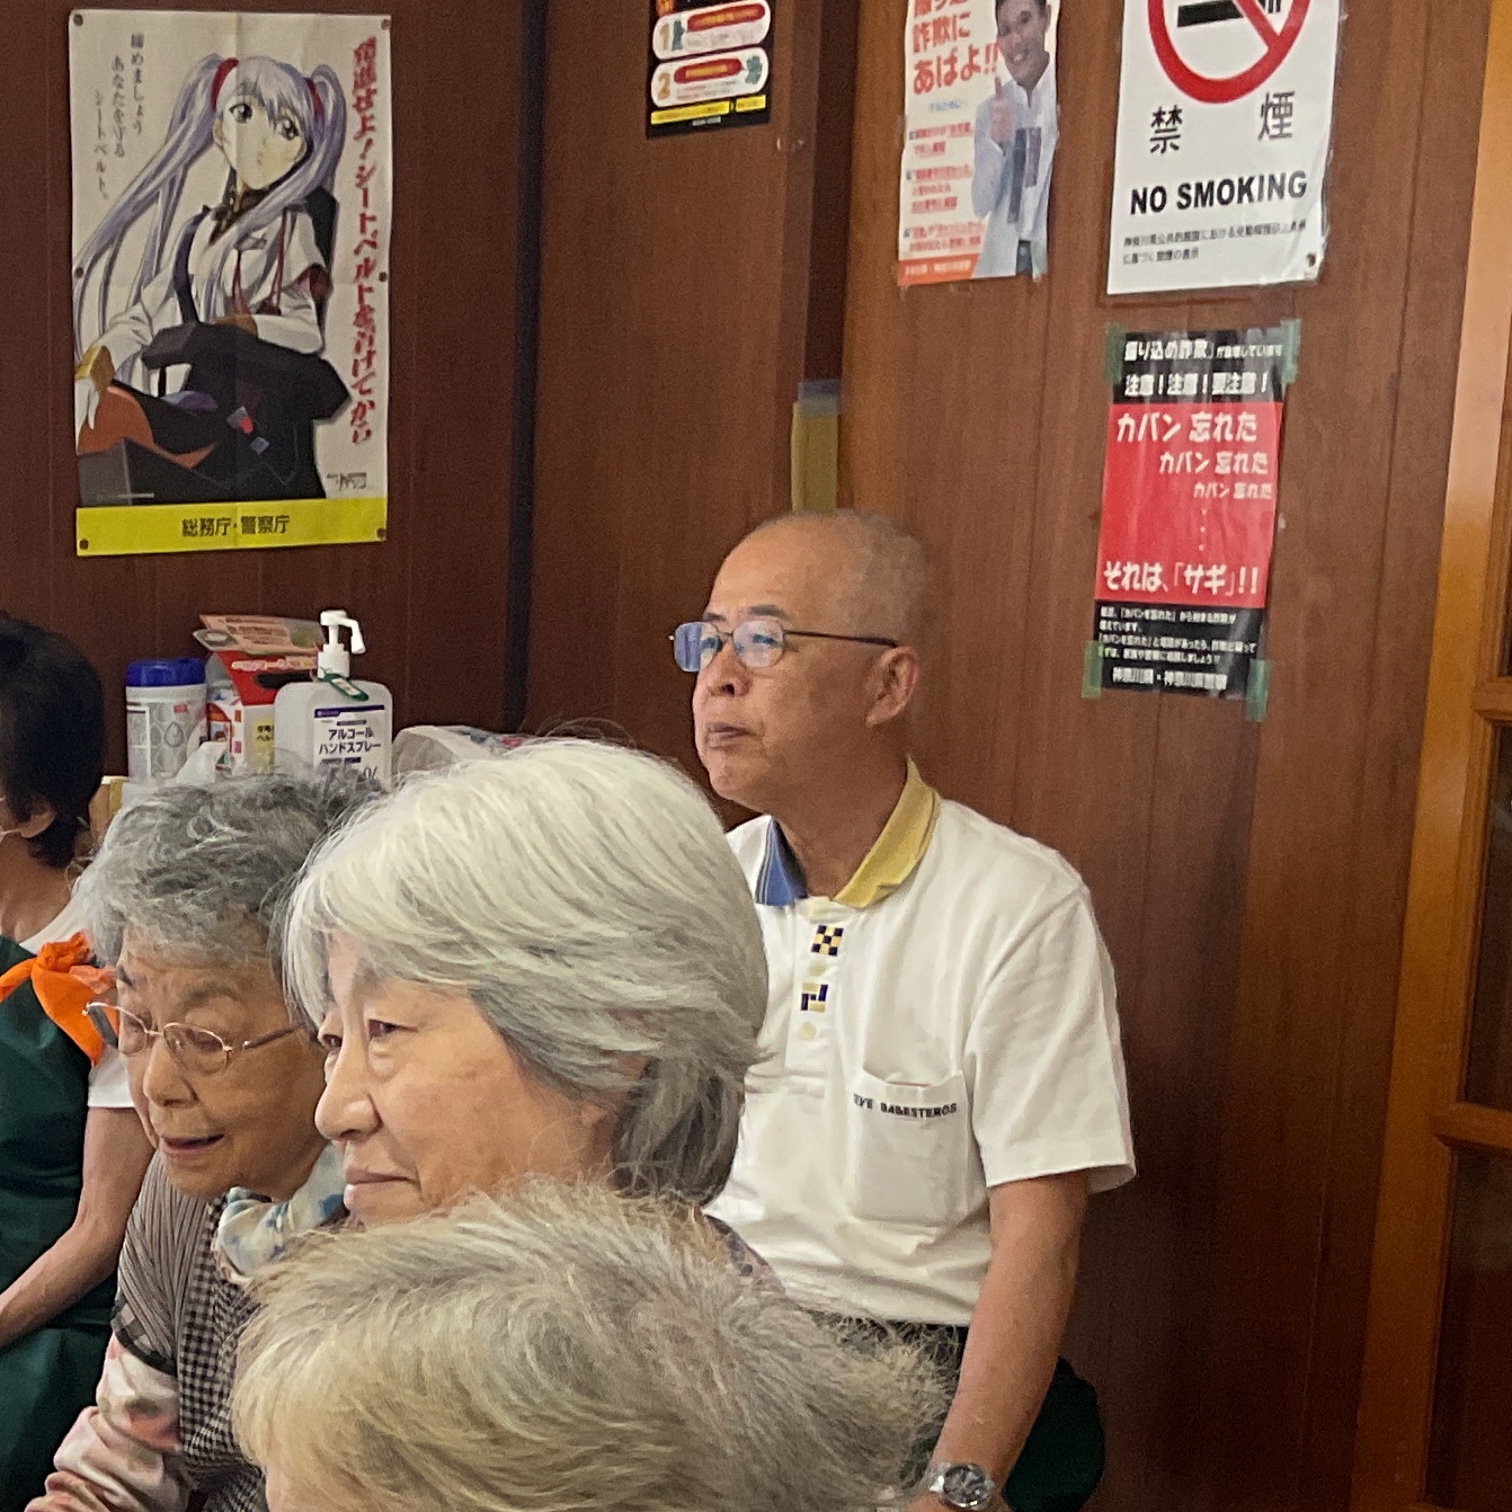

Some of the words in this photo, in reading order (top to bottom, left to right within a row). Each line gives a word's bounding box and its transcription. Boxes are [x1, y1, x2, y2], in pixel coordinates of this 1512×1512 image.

[1150, 104, 1183, 154] 禁
[1257, 91, 1295, 141] 煙
[1130, 186, 1167, 215] NO
[1176, 170, 1308, 210] SMOKING
[1117, 413, 1181, 443] カバン
[1189, 412, 1258, 442] 忘れた
[1159, 451, 1210, 475] カバン
[1214, 452, 1269, 475] 忘れた
[1193, 482, 1230, 500] カバン
[1233, 482, 1272, 500] 忘れた
[328, 726, 374, 741] アルコール
[318, 741, 382, 756] ハンドスプレー
